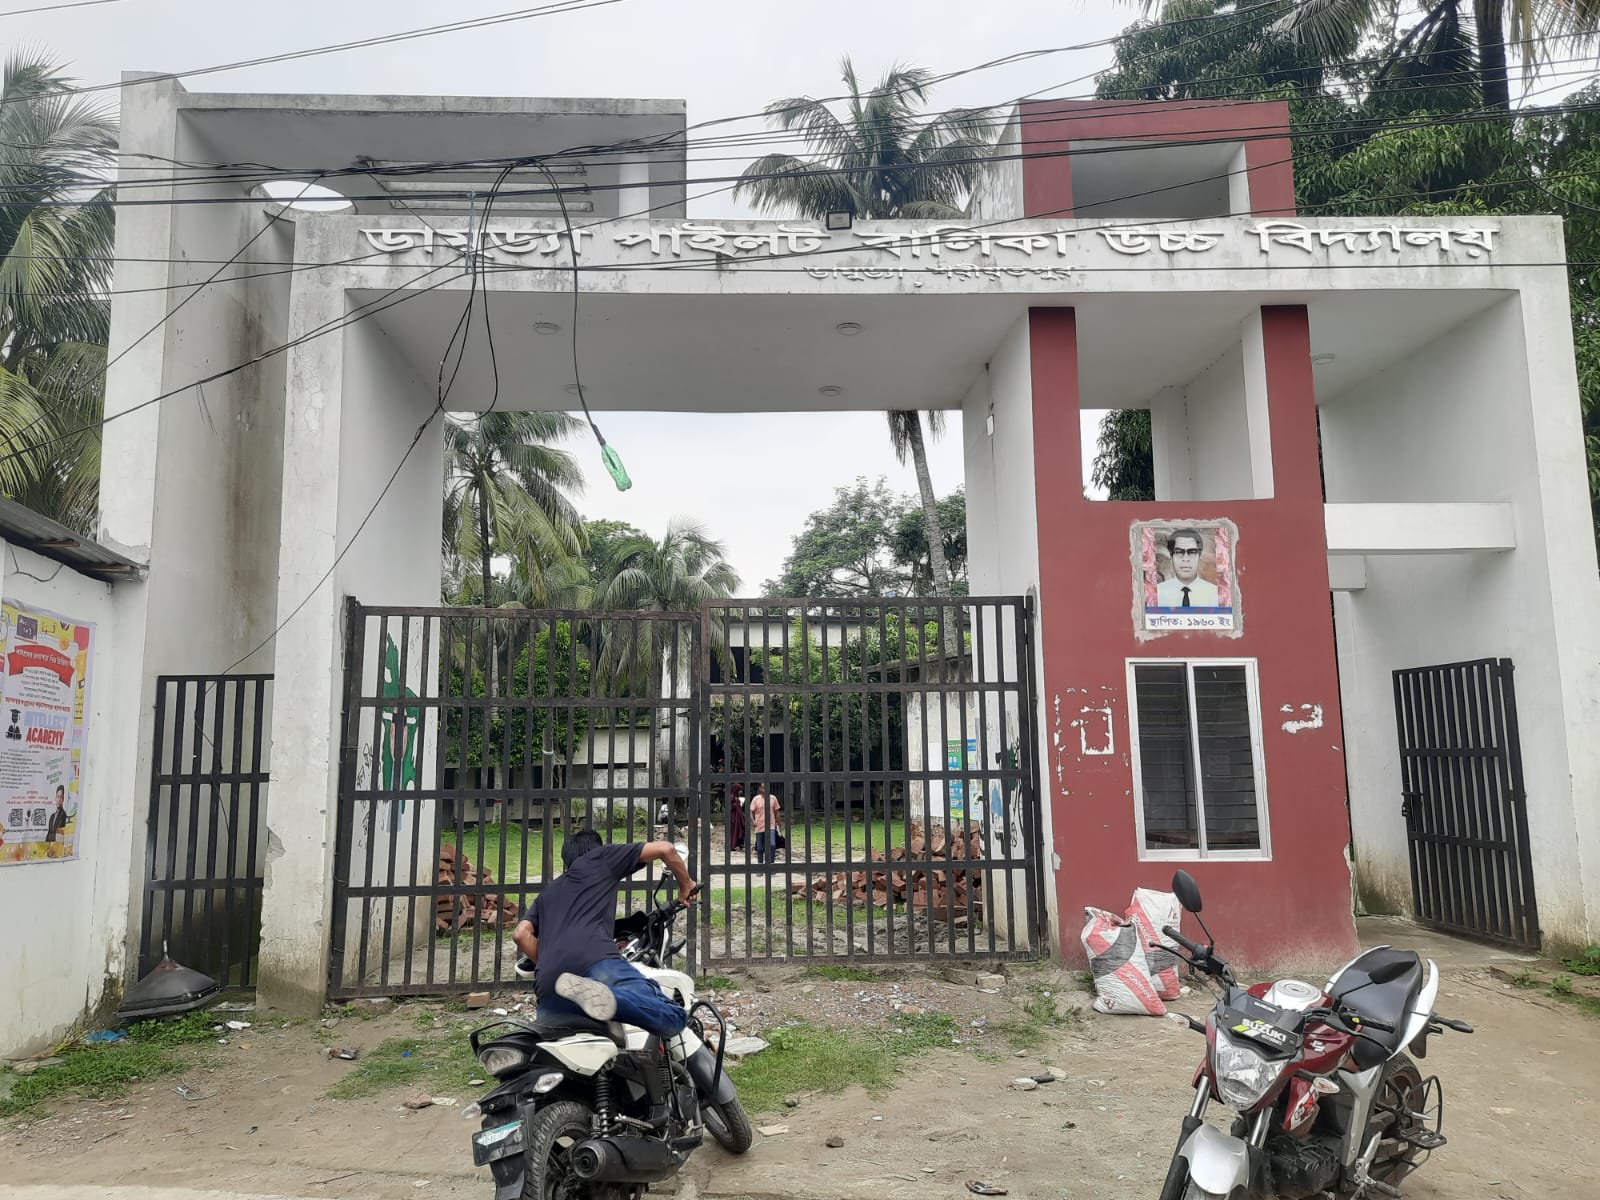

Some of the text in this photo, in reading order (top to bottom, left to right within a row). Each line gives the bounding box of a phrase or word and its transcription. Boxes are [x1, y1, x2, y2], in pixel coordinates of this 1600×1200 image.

[614, 222, 832, 259] পাইলট
[854, 224, 1077, 258] বালিকা
[1096, 222, 1225, 255] উচ্চ
[1245, 220, 1500, 258] বিদ্যালয়
[25, 727, 65, 746] ACADEMY
[1241, 1018, 1288, 1042] SUZUKI
